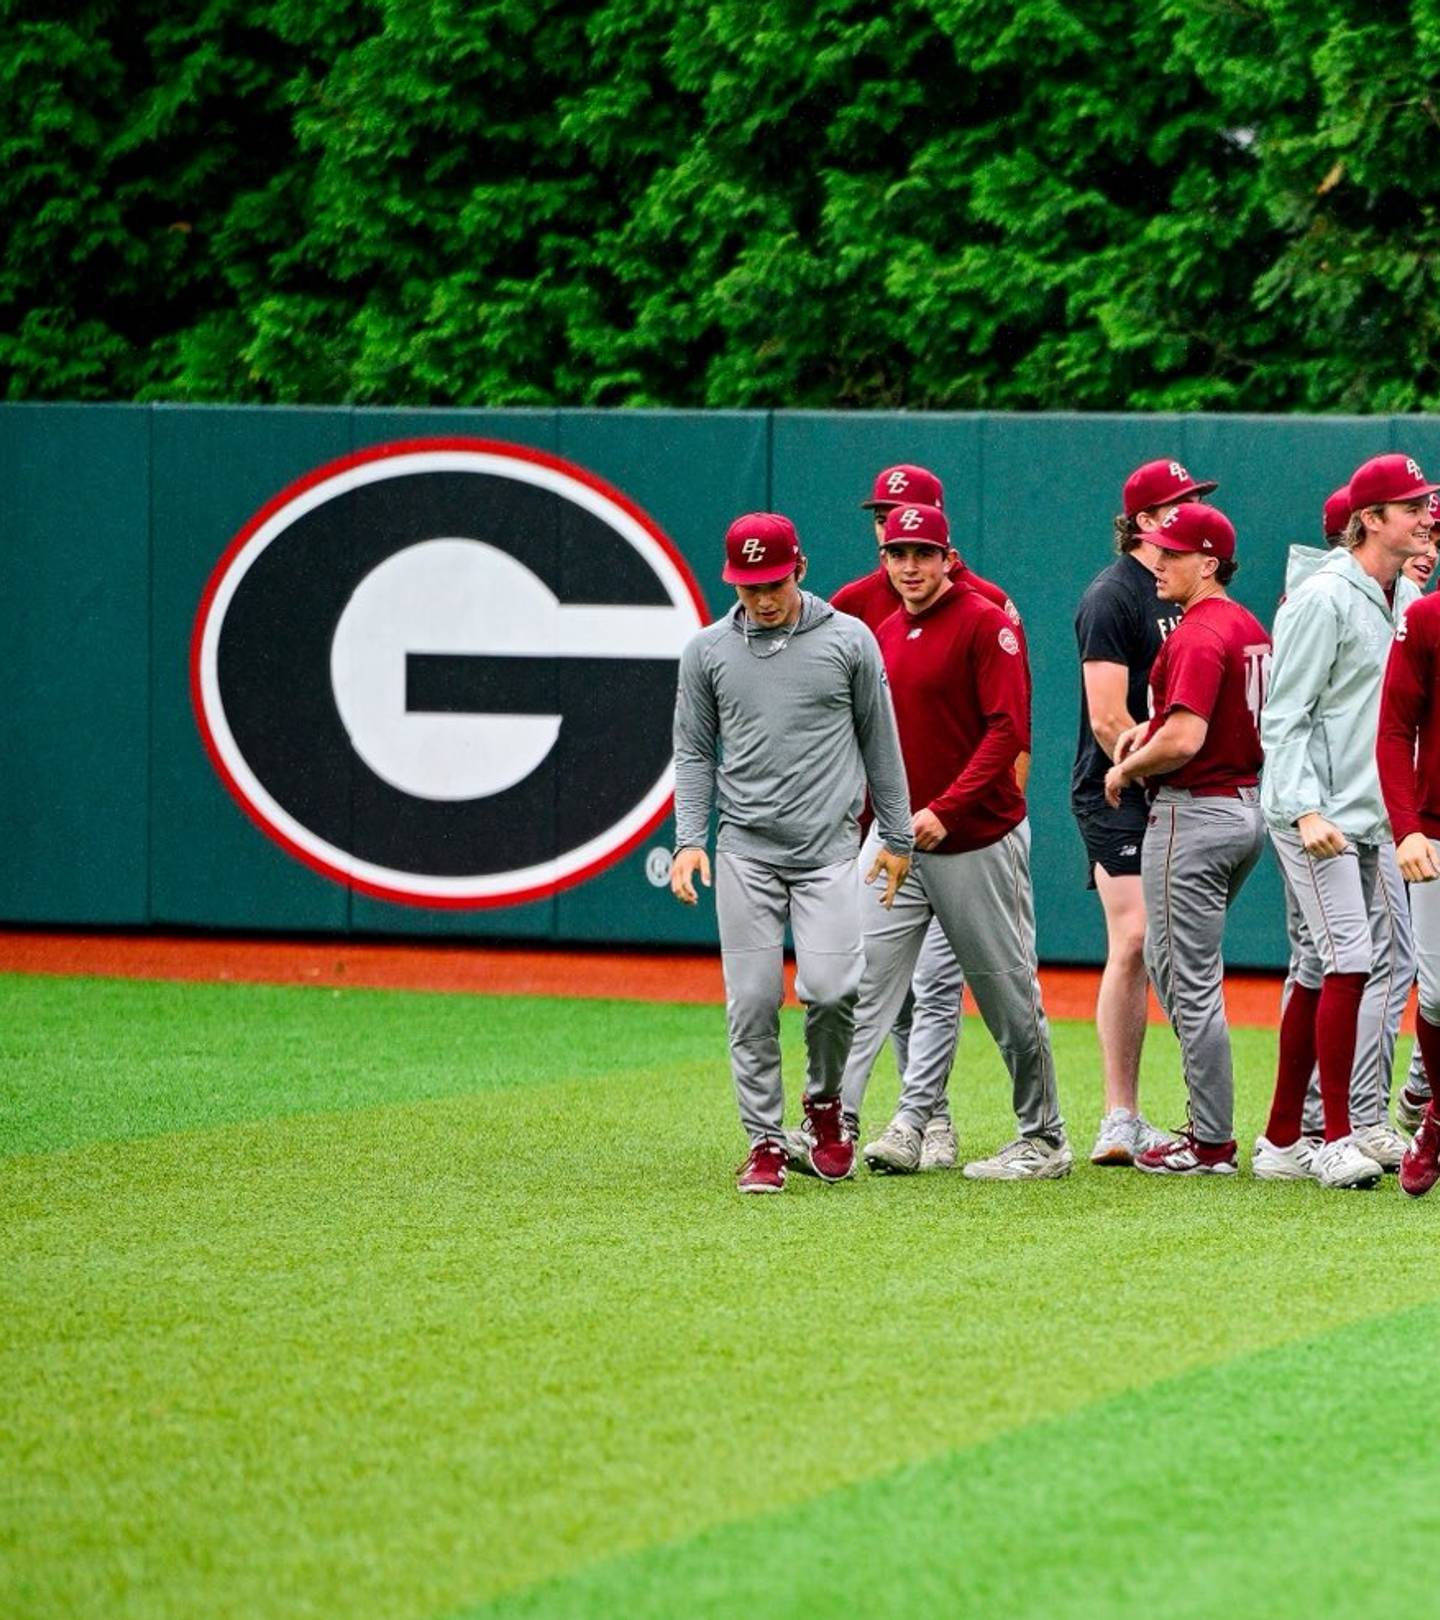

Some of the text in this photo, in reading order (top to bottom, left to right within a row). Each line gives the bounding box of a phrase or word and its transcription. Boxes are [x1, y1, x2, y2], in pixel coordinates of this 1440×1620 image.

[887, 471, 909, 494] BC
[1168, 461, 1189, 482] BC
[900, 508, 924, 531] BC
[741, 538, 766, 563] BC
[217, 470, 677, 878] G
